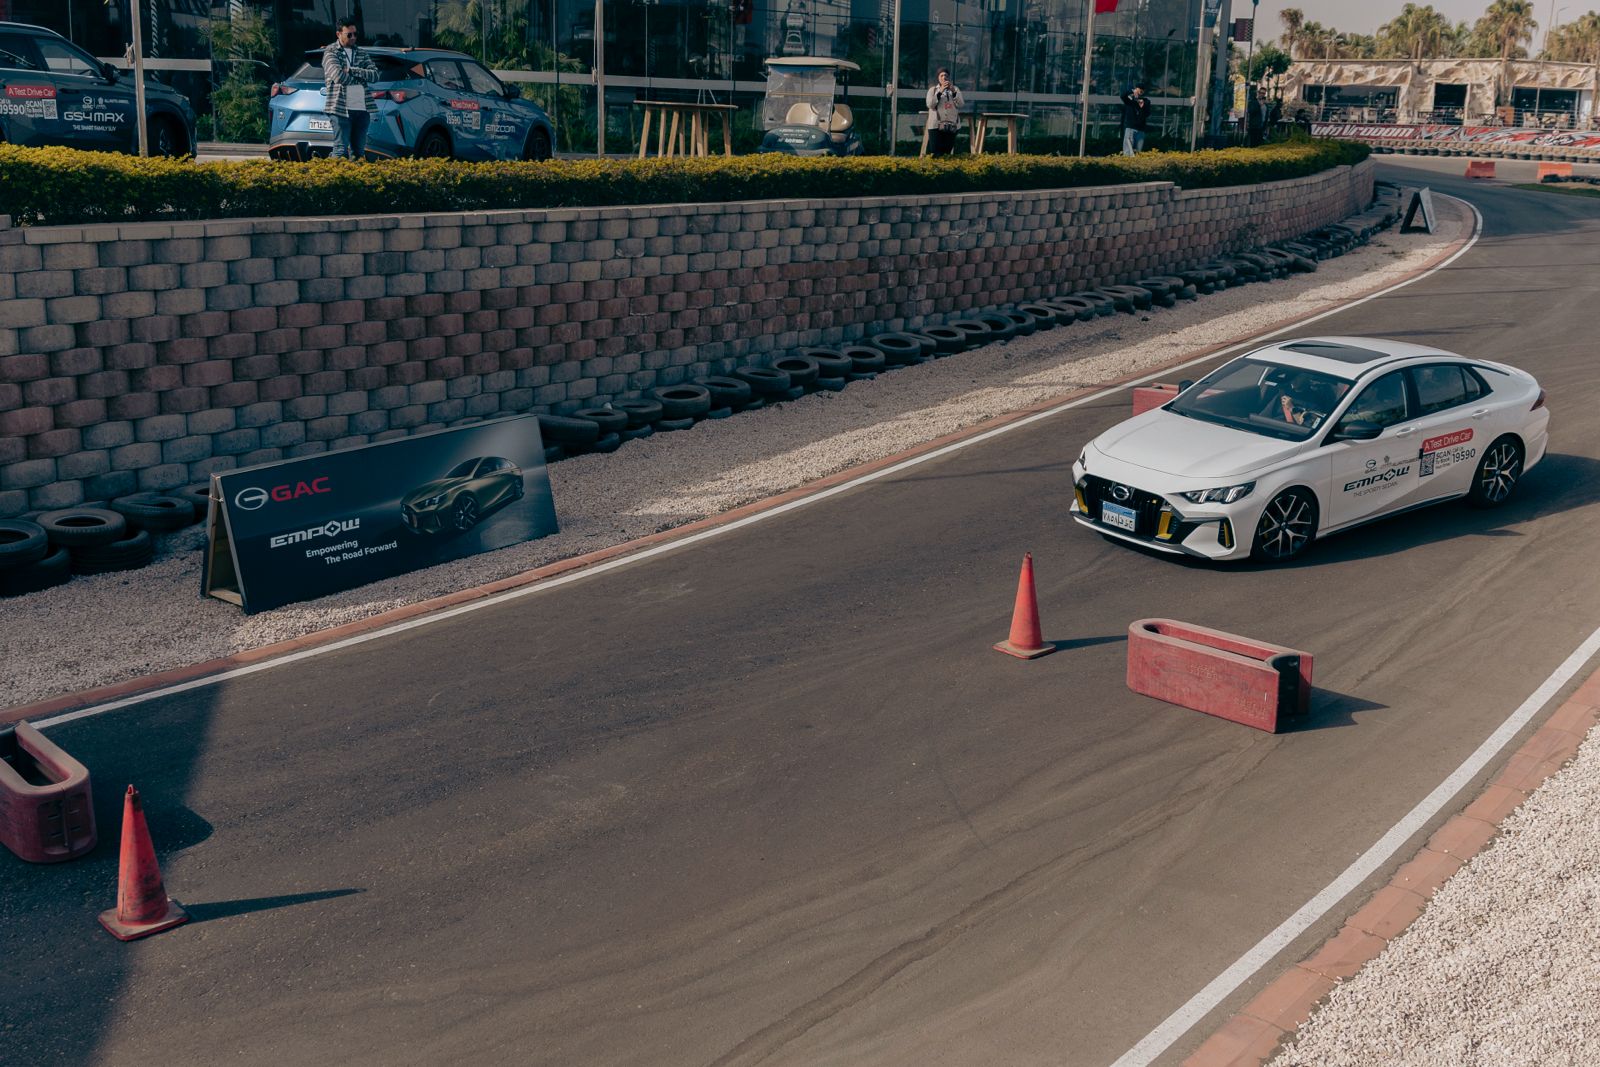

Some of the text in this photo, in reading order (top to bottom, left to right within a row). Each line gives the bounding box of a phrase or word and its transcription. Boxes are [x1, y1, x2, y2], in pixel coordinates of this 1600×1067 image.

[14, 88, 26, 96] Test
[27, 88, 43, 97] Drive
[43, 89, 54, 97] Car
[0, 104, 25, 115] 19590
[25, 100, 43, 108] SCAN
[1424, 431, 1472, 451] A Test Drive Car
[1452, 448, 1476, 464] 19590
[1343, 466, 1410, 492] EMPOW
[271, 476, 332, 502] GAC
[270, 517, 360, 548] EMPOW
[306, 540, 359, 558] Empowering
[325, 540, 398, 565] The Road Forward
